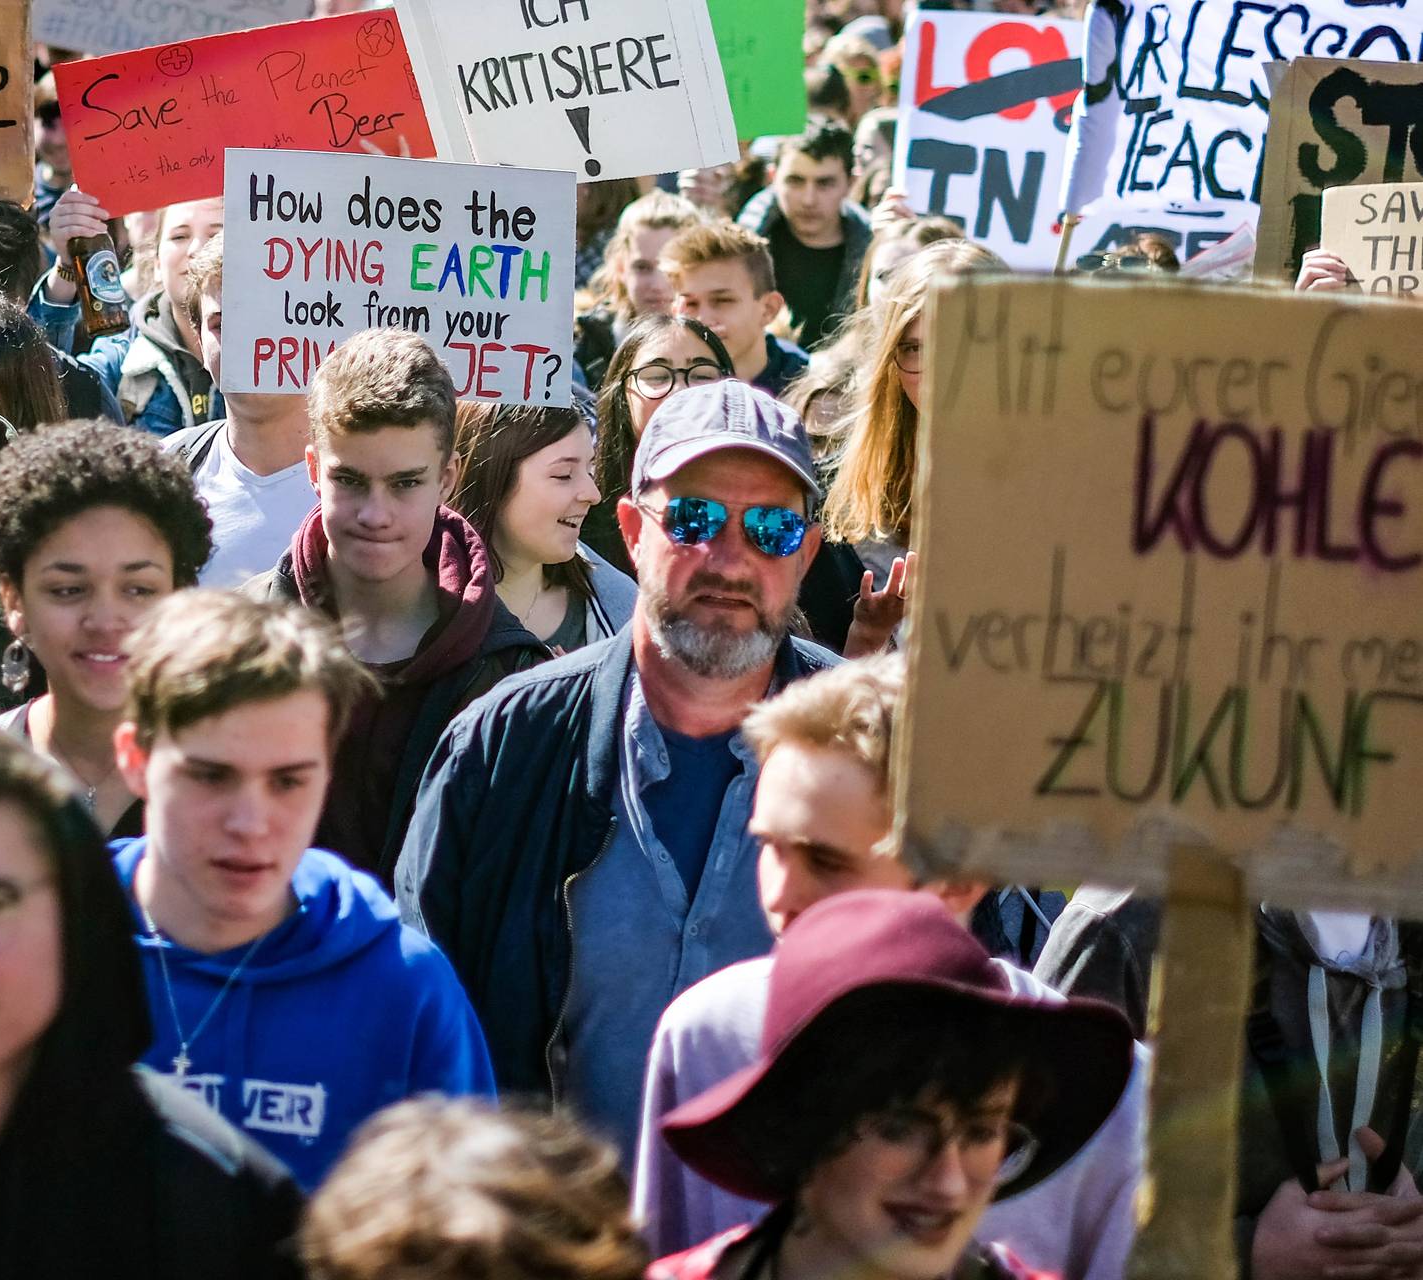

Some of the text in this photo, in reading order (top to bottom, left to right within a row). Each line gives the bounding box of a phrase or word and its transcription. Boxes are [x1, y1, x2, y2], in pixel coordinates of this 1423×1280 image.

[80, 50, 379, 141] Save the Planet
[457, 34, 680, 115] KRITISIERE
[308, 92, 406, 149] Beer
[565, 106, 602, 178] !
[1298, 65, 1423, 188] ST
[156, 154, 183, 176] the
[188, 147, 216, 168] only
[249, 171, 537, 242] How does the
[263, 237, 552, 302] DYING EARTH
[1345, 275, 1420, 298] AR
[1362, 235, 1423, 271] TH
[284, 289, 511, 348] look from your
[941, 286, 1067, 417] Mit
[253, 336, 563, 401] PRIV JET?
[1130, 409, 1423, 575] KOHLE
[934, 545, 1198, 685] verheizt
[1237, 555, 1327, 690] ihr
